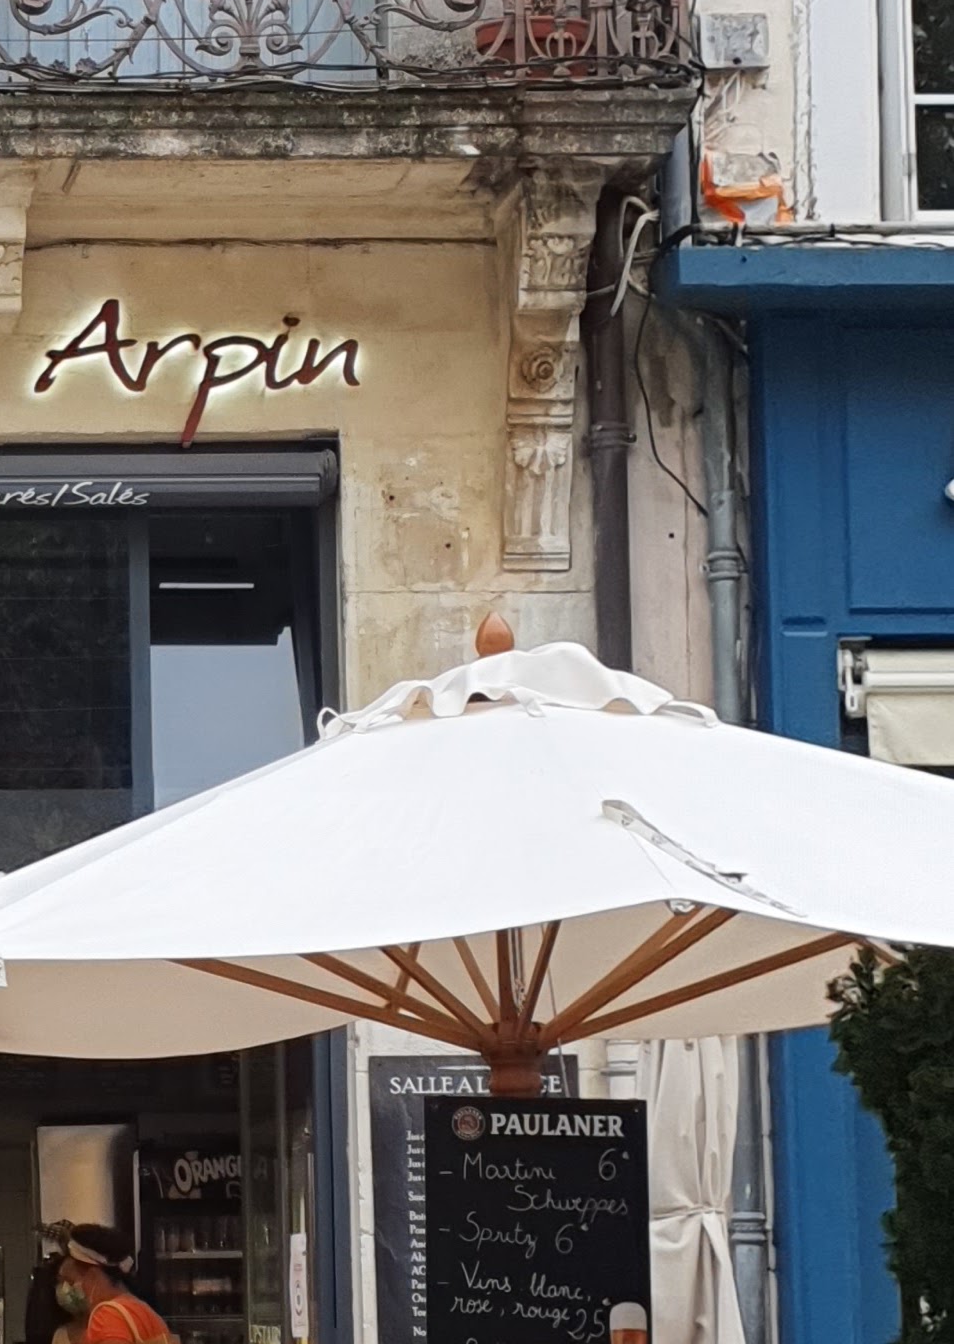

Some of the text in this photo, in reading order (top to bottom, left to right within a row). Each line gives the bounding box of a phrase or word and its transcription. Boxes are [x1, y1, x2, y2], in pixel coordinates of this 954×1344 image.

[35, 299, 361, 446] Arpin
[390, 1076, 454, 1094] SALLE
[490, 1113, 625, 1137] PAULANER
[463, 1152, 556, 1180] Martini
[459, 1211, 538, 1259] Spritz
[461, 1260, 512, 1292] Vins
[512, 1302, 570, 1328] rouge
